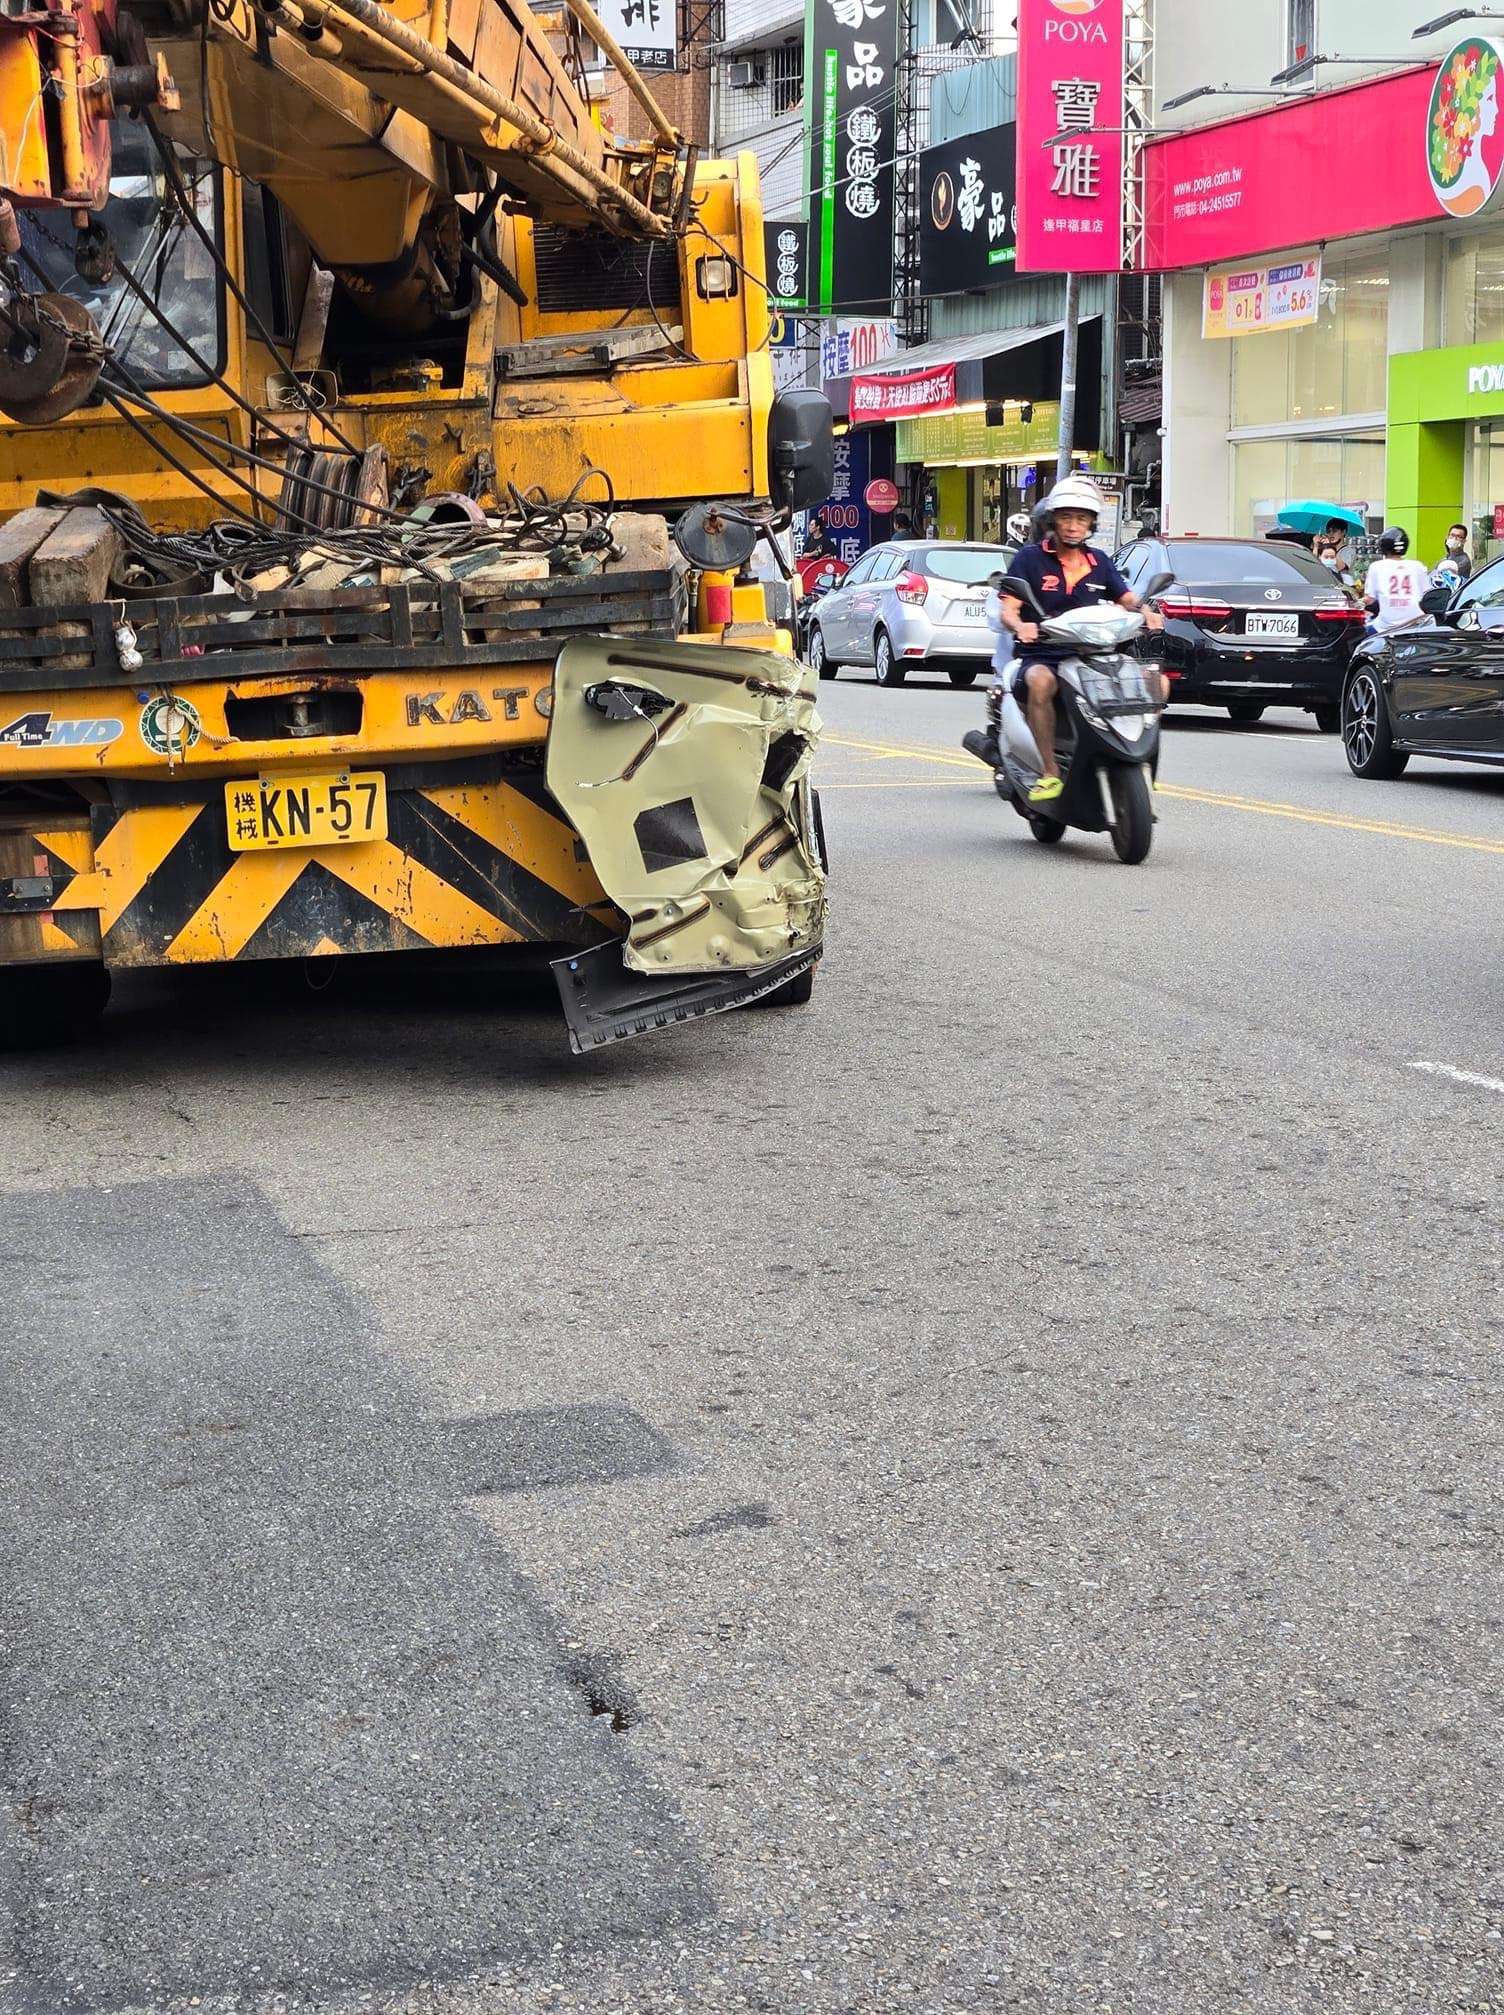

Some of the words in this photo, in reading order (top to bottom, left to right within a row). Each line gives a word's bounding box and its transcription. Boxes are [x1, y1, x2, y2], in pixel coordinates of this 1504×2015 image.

[1044, 20, 1108, 43] POYA
[623, 49, 667, 64] 甲老店
[1051, 77, 1100, 197] 寶雅
[1173, 167, 1242, 197] www.poya.com.tw
[818, 505, 860, 529] 100
[1389, 575, 1412, 594] 24
[23, 732, 43, 740] Time
[234, 791, 258, 840] 機械
[260, 783, 378, 838] KN-57
